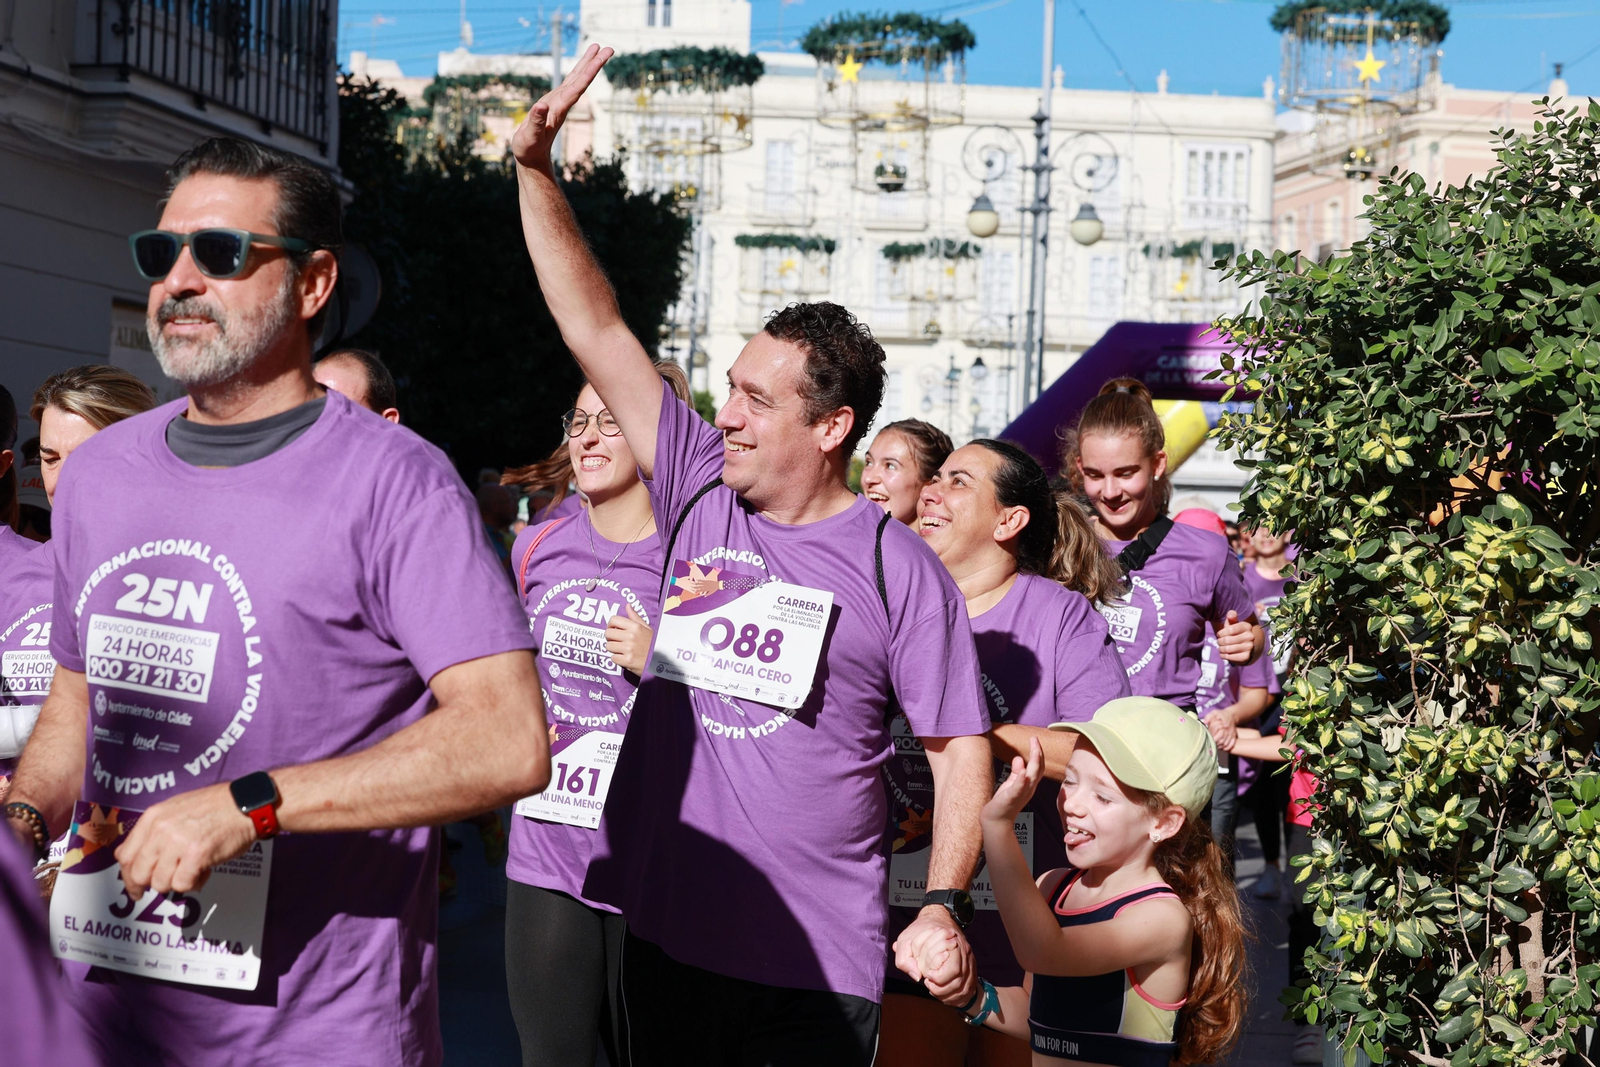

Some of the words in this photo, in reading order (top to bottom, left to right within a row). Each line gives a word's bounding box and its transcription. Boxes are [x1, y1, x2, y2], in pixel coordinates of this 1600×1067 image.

[75, 539, 212, 617] INTERNACIONAL
[115, 573, 214, 624] 25N
[213, 555, 257, 634] CONTRA
[533, 578, 620, 615] INTERNACINAL
[777, 596, 824, 613] CARRERA
[1131, 576, 1165, 611] CONTRA
[1157, 612, 1167, 627] LA
[563, 593, 621, 625] 25N
[767, 614, 787, 623] CONTRA
[798, 621, 820, 630] MUJERES
[791, 608, 823, 619] ELIMINACIÓN
[795, 615, 821, 625] VIOLENCIA
[1104, 611, 1126, 624] RAS
[93, 621, 134, 633] SERVICIO
[135, 627, 148, 637] DE
[150, 630, 212, 647] EMERGENCIAS
[549, 620, 574, 632] SERVICIO
[574, 627, 581, 635] DE
[555, 630, 568, 643] 24
[700, 617, 784, 663] 088
[1113, 626, 1131, 637] 30
[103, 635, 123, 654] 24
[126, 639, 194, 666] HORAS
[244, 636, 262, 668] LA
[545, 642, 571, 659] 900
[572, 650, 585, 661] 21
[586, 653, 598, 665] 21
[598, 656, 616, 670] 30
[12, 662, 25, 674] 24
[26, 662, 54, 674] HOR
[90, 656, 123, 679] 900
[125, 662, 150, 684] 21
[151, 667, 174, 689] 21
[175, 671, 202, 693] 30
[676, 647, 755, 677] TOLANCIA
[757, 667, 792, 684] CERO
[4, 678, 27, 691] 900
[29, 678, 42, 691] 21
[44, 678, 53, 691] 2
[981, 673, 1009, 717] ONTRA
[155, 709, 167, 722] de
[183, 673, 262, 777] VIOLENCIA
[552, 705, 576, 723] LAS
[578, 712, 619, 727] HACIA
[701, 713, 745, 739] HACIA
[114, 770, 176, 795] HACIA
[556, 762, 601, 797] 161
[540, 792, 550, 802] NI
[550, 793, 571, 805] UNA
[573, 797, 604, 810] MENO
[898, 880, 912, 889] TU
[914, 880, 927, 889] LU
[64, 915, 79, 931] EL
[83, 919, 132, 942] AMOR
[135, 929, 162, 946] NO
[165, 934, 244, 956] LASTIMA
[1034, 1033, 1046, 1049] RUN
[1046, 1036, 1061, 1053] FOR
[1062, 1040, 1079, 1056] FUN
